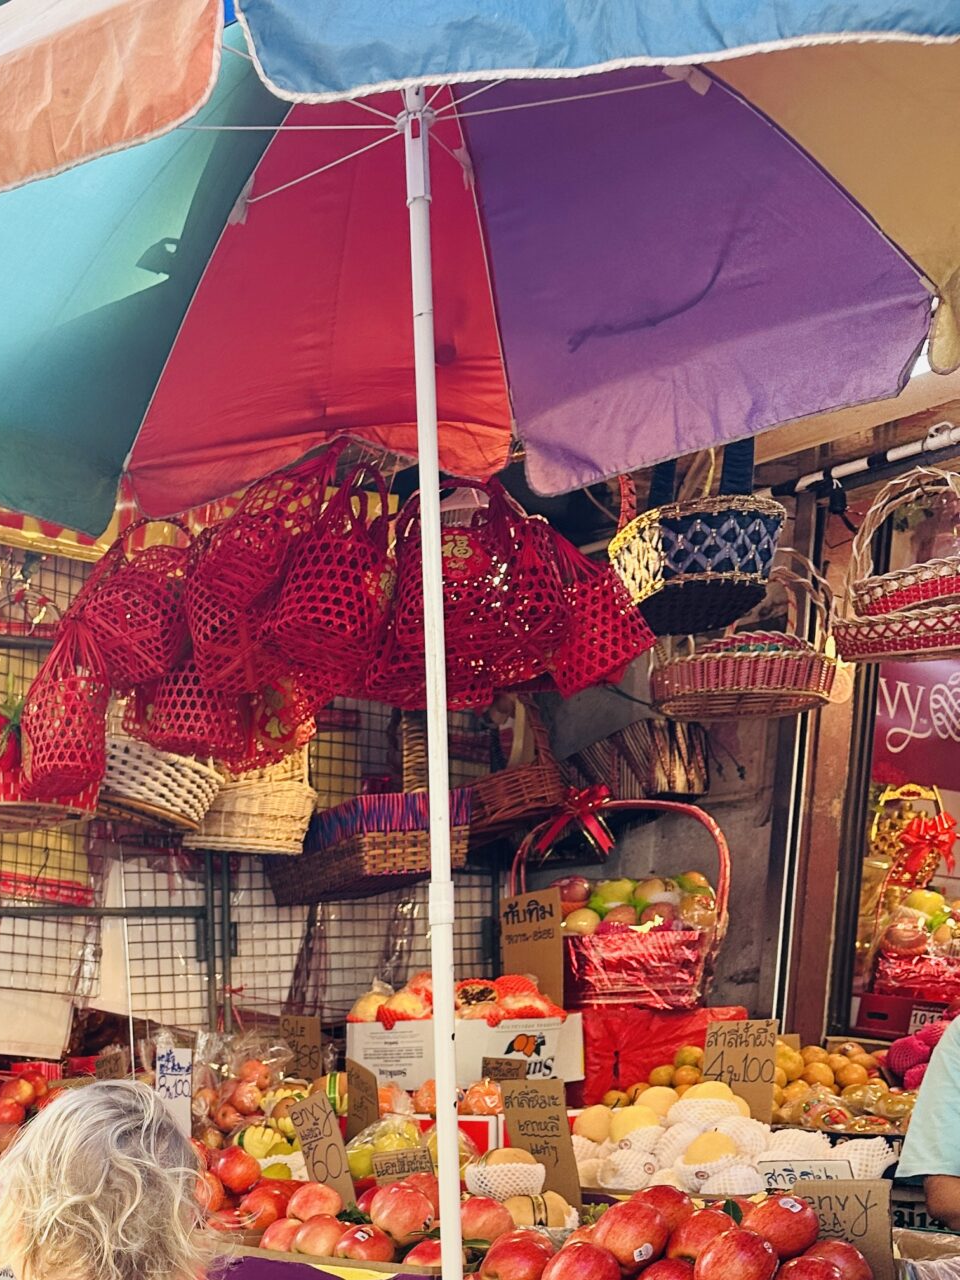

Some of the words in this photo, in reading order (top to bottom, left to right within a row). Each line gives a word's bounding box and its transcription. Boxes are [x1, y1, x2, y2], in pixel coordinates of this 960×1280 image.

[876, 677, 932, 753] vy
[503, 899, 554, 925] ทับทิม
[706, 1020, 776, 1050] สาลี่น้ำผึ้ง
